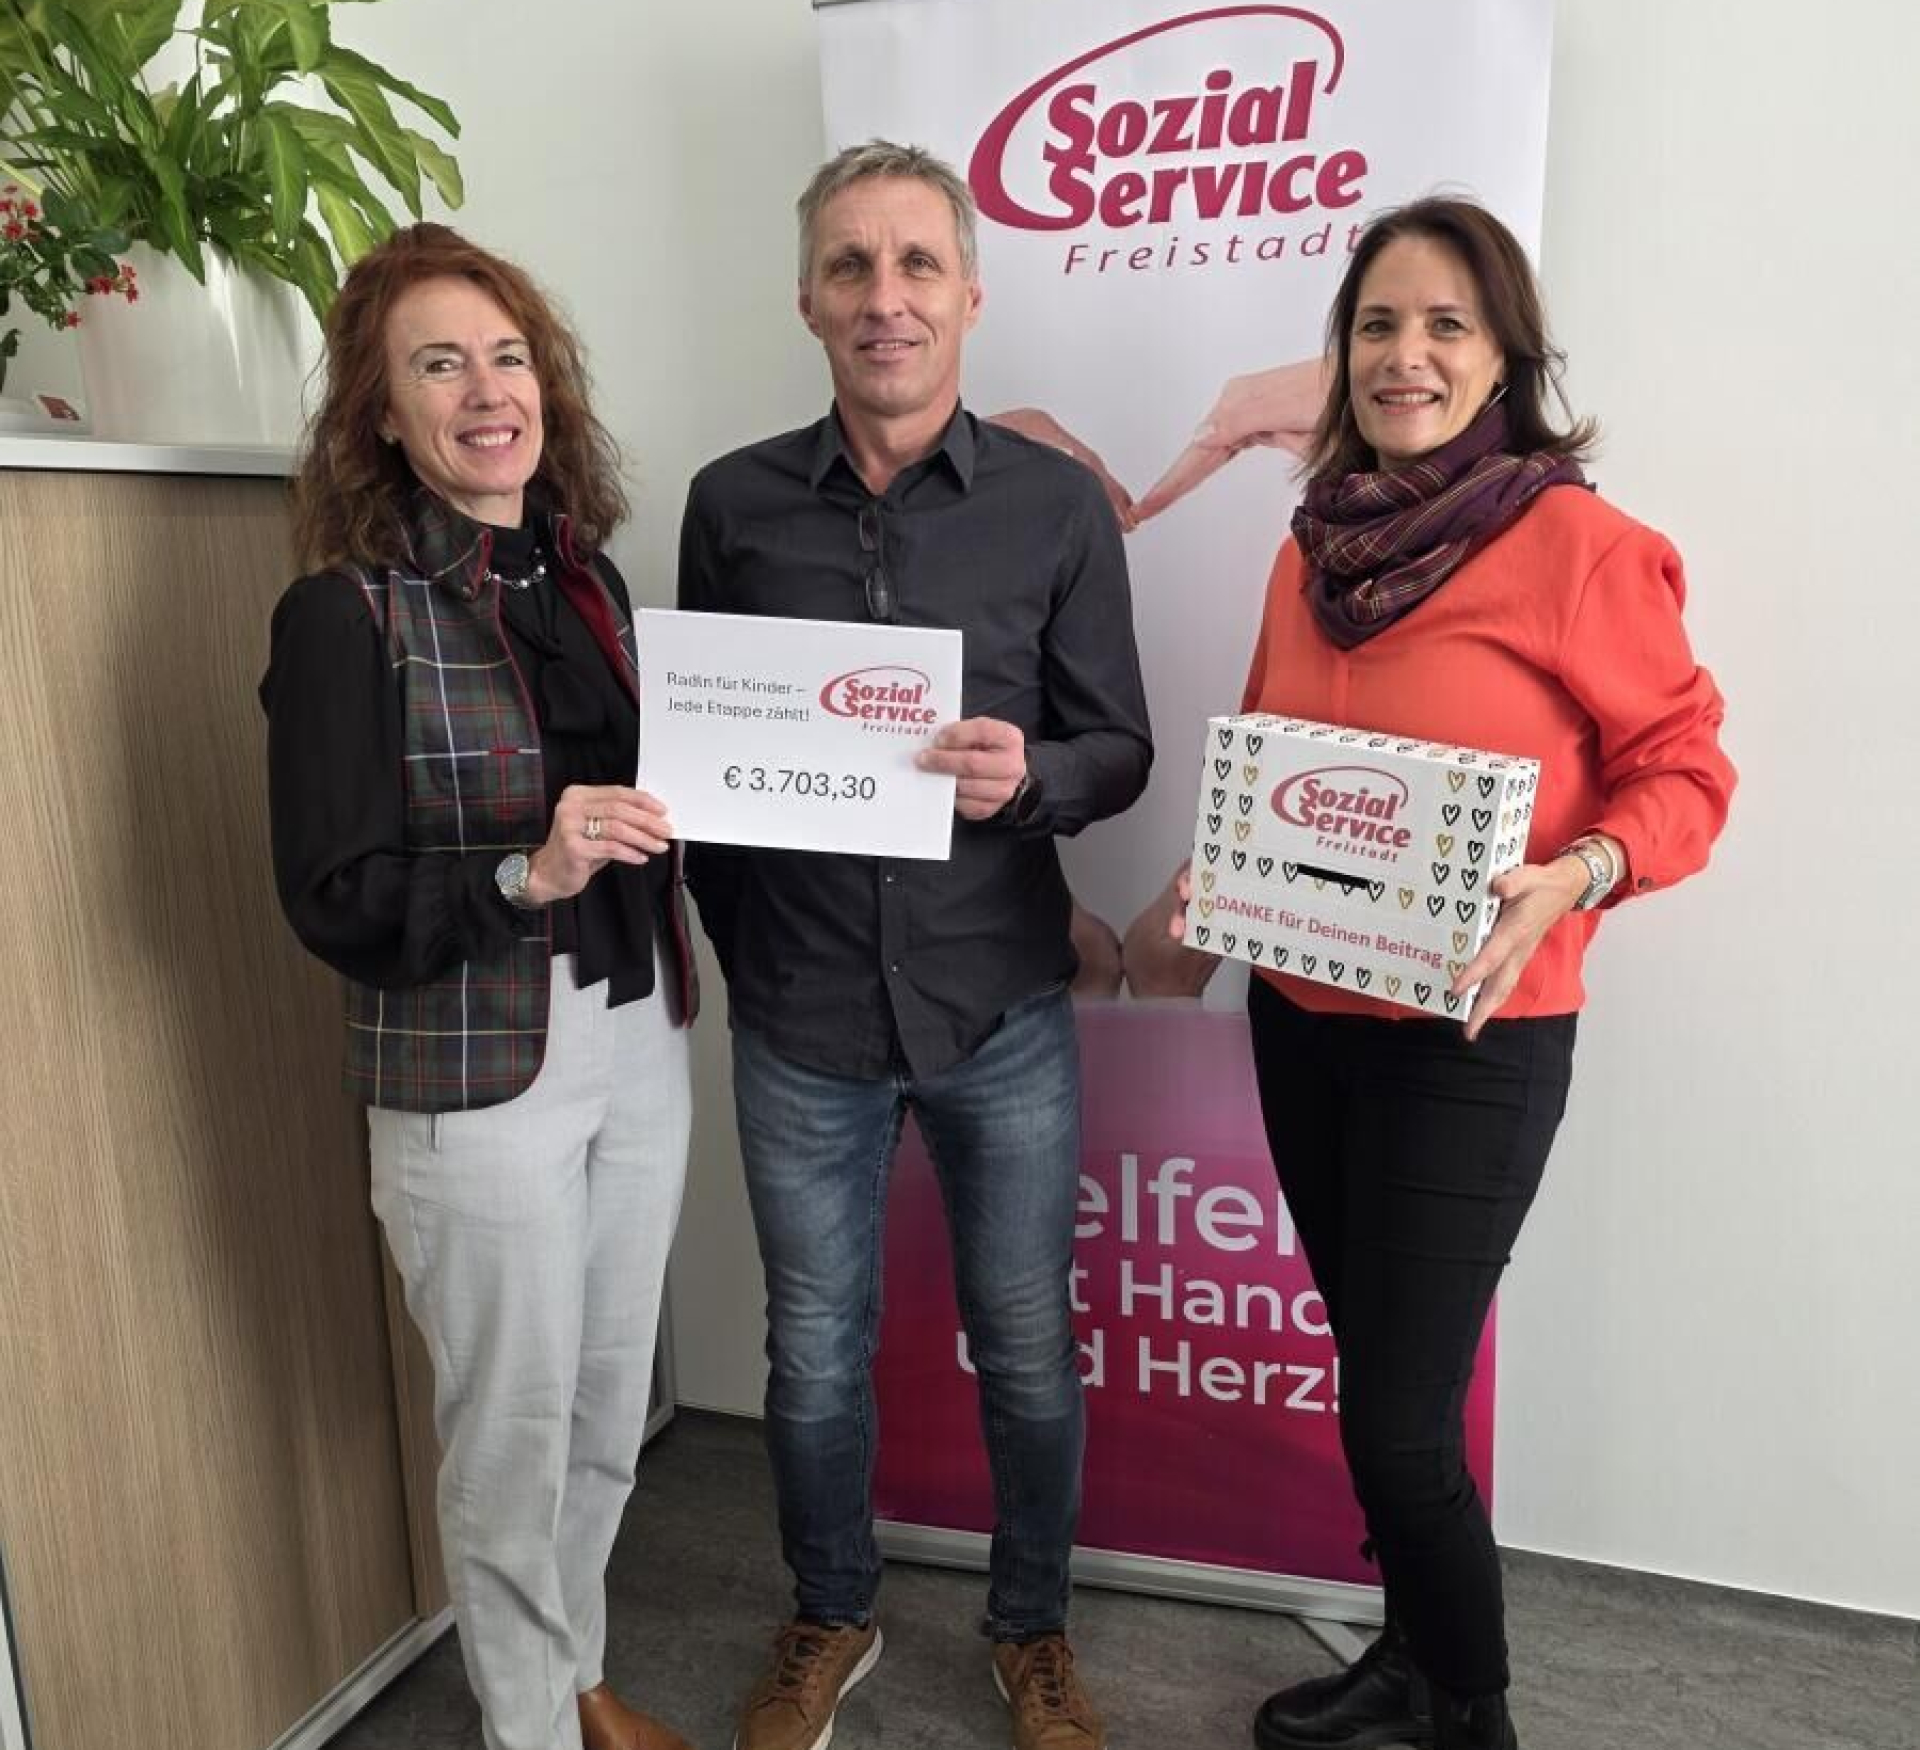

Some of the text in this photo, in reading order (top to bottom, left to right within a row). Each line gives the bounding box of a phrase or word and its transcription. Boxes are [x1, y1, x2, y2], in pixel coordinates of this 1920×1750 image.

[1043, 60, 1317, 162] Sozial
[1047, 149, 1368, 231] Service
[1064, 222, 1363, 275] Freistadt
[716, 676, 738, 690] für
[742, 678, 793, 694] Kinder
[843, 678, 924, 704] Sozial
[668, 697, 809, 722] Jede Etappe zählt!
[844, 698, 937, 724] Service
[722, 765, 877, 801] € 3.703,30
[1299, 778, 1398, 820] Sozial
[1299, 804, 1411, 848] Service
[1315, 836, 1399, 862] Freistadt
[1215, 894, 1444, 970] DANKE für Deinen Beitrag
